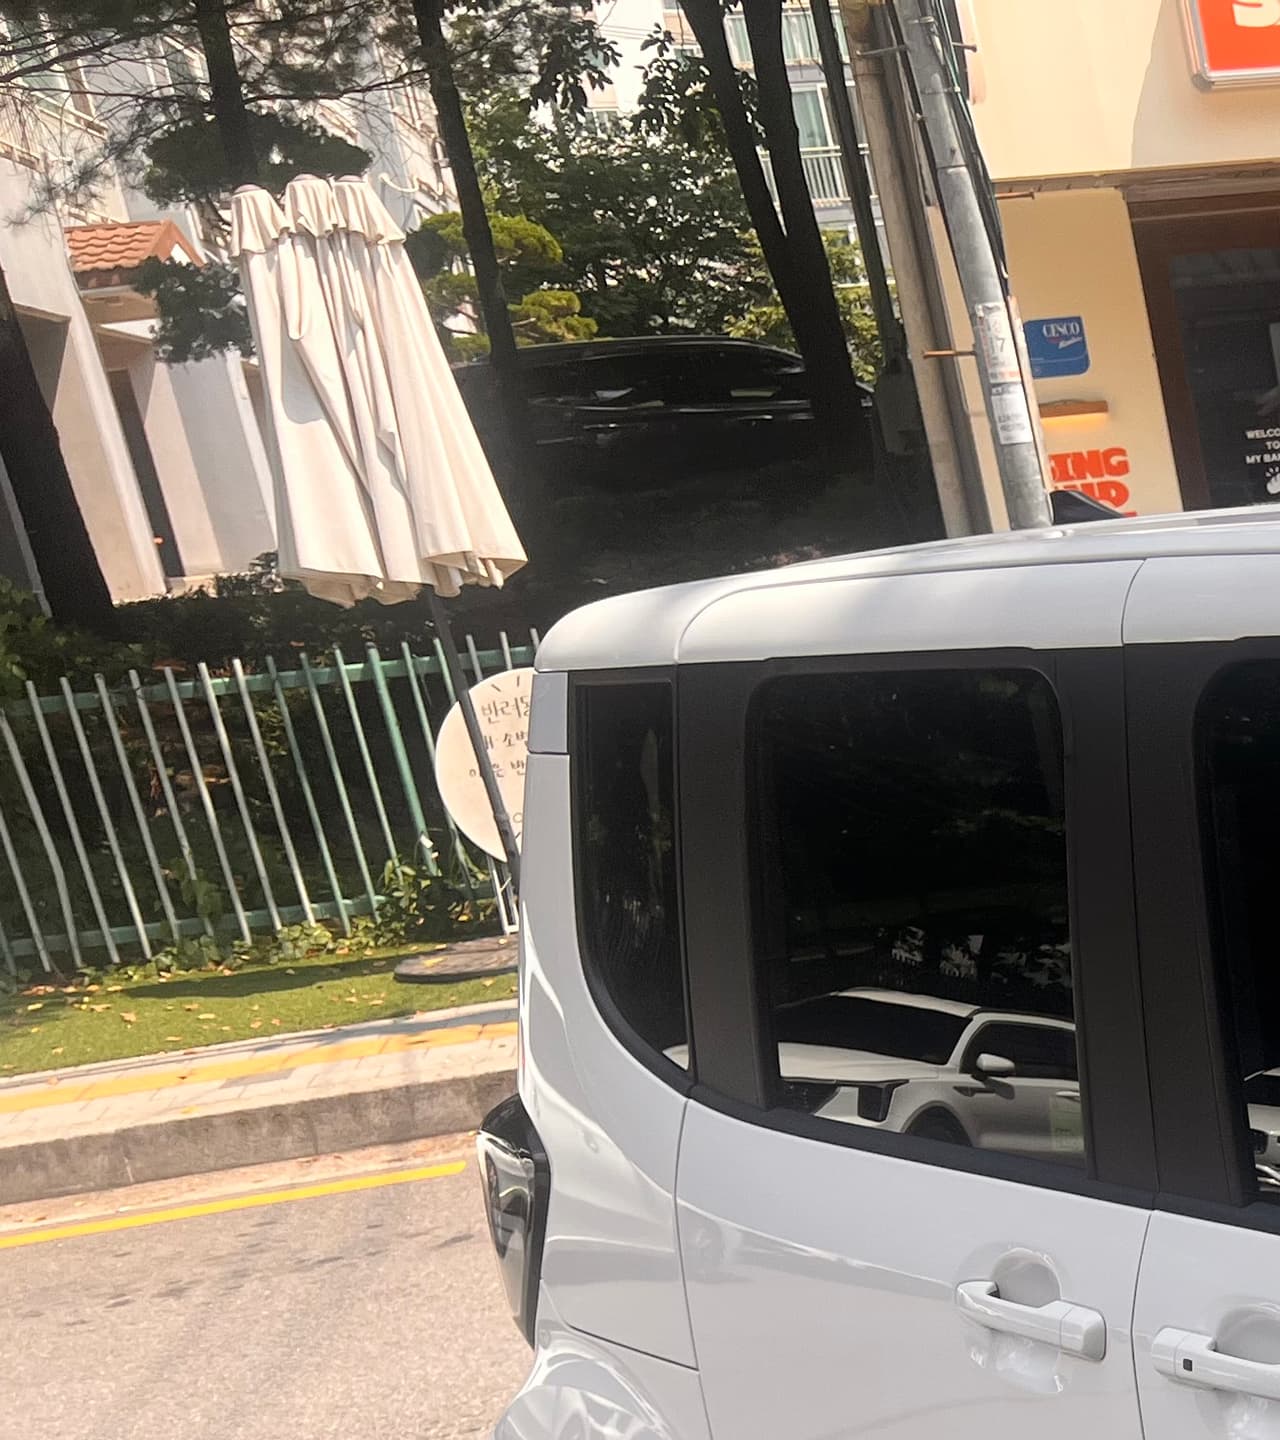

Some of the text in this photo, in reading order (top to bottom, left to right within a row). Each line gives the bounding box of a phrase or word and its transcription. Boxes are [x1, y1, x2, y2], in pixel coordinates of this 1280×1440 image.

[1042, 321, 1080, 338] CESCO
[1265, 440, 1280, 450] TO
[1245, 455, 1261, 464] MY
